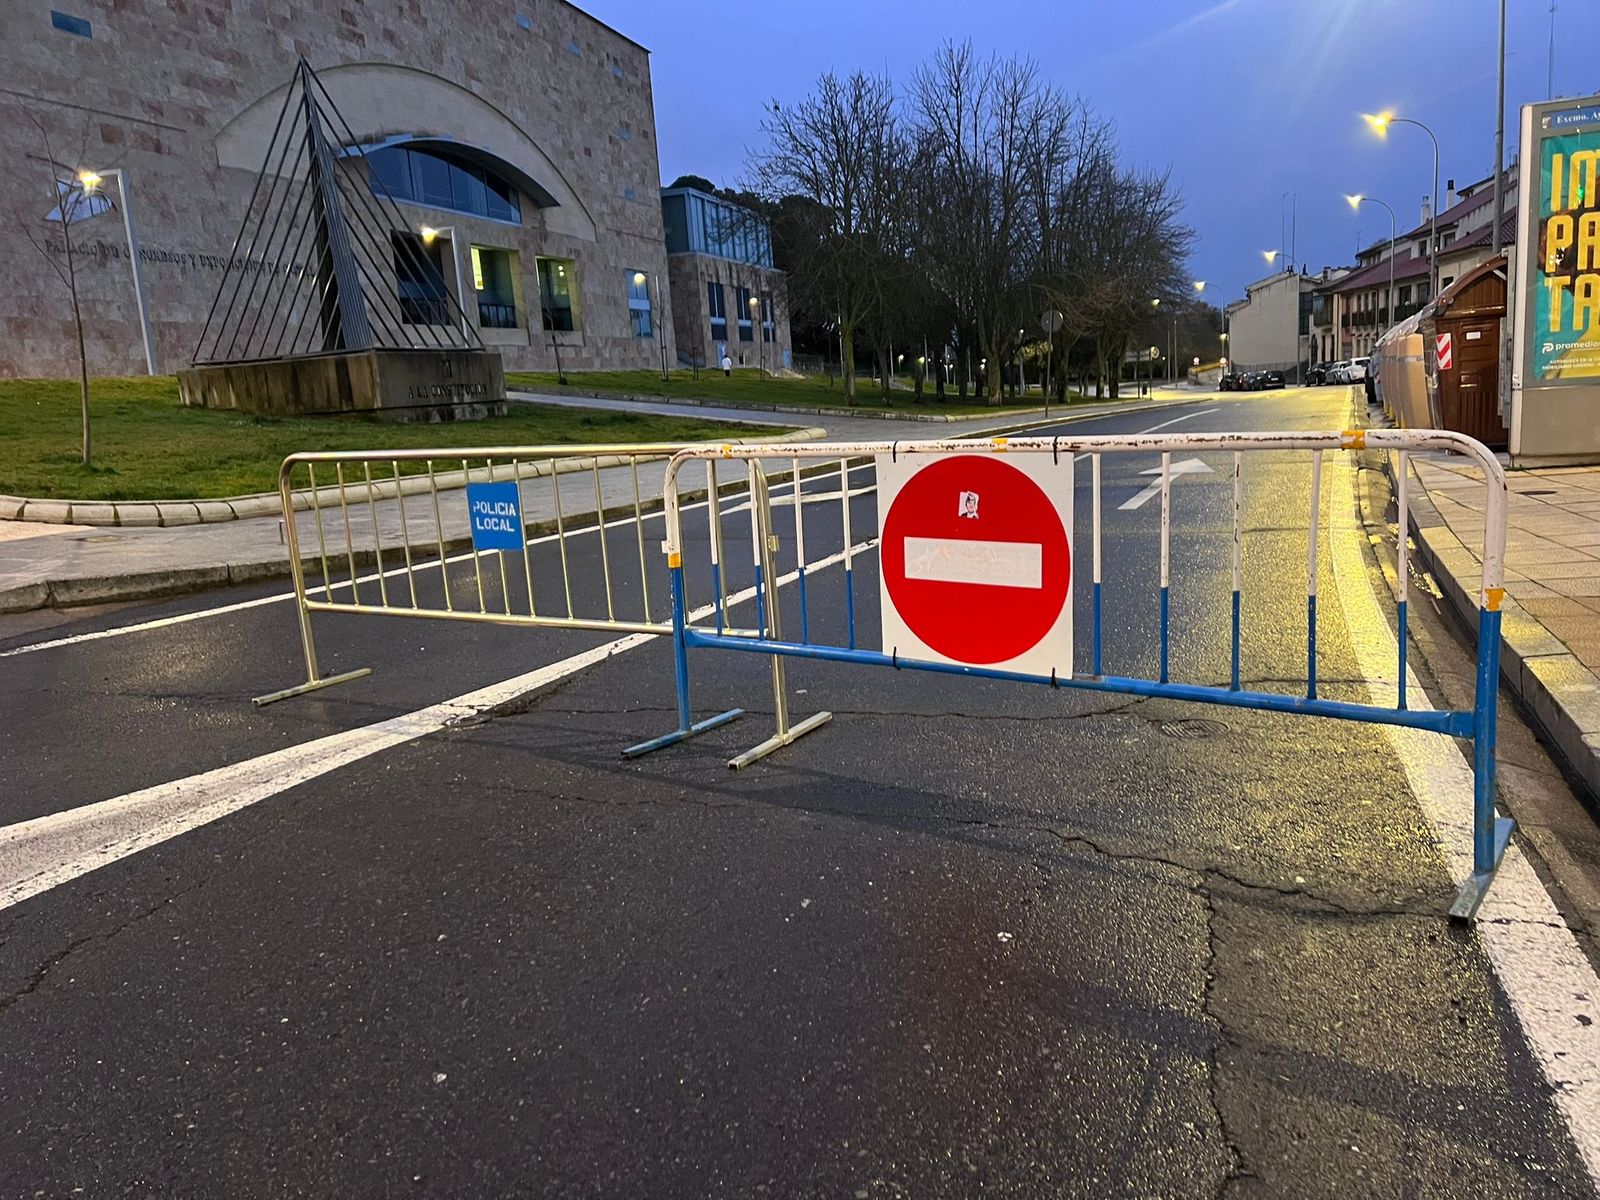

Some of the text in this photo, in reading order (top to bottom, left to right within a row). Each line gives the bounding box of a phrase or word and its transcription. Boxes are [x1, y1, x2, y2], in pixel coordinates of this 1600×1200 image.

[123, 242, 187, 266] CNGRESOS
[1555, 340, 1600, 351] promedio
[473, 501, 516, 517] POLICIA
[476, 517, 515, 532] LOCAL
